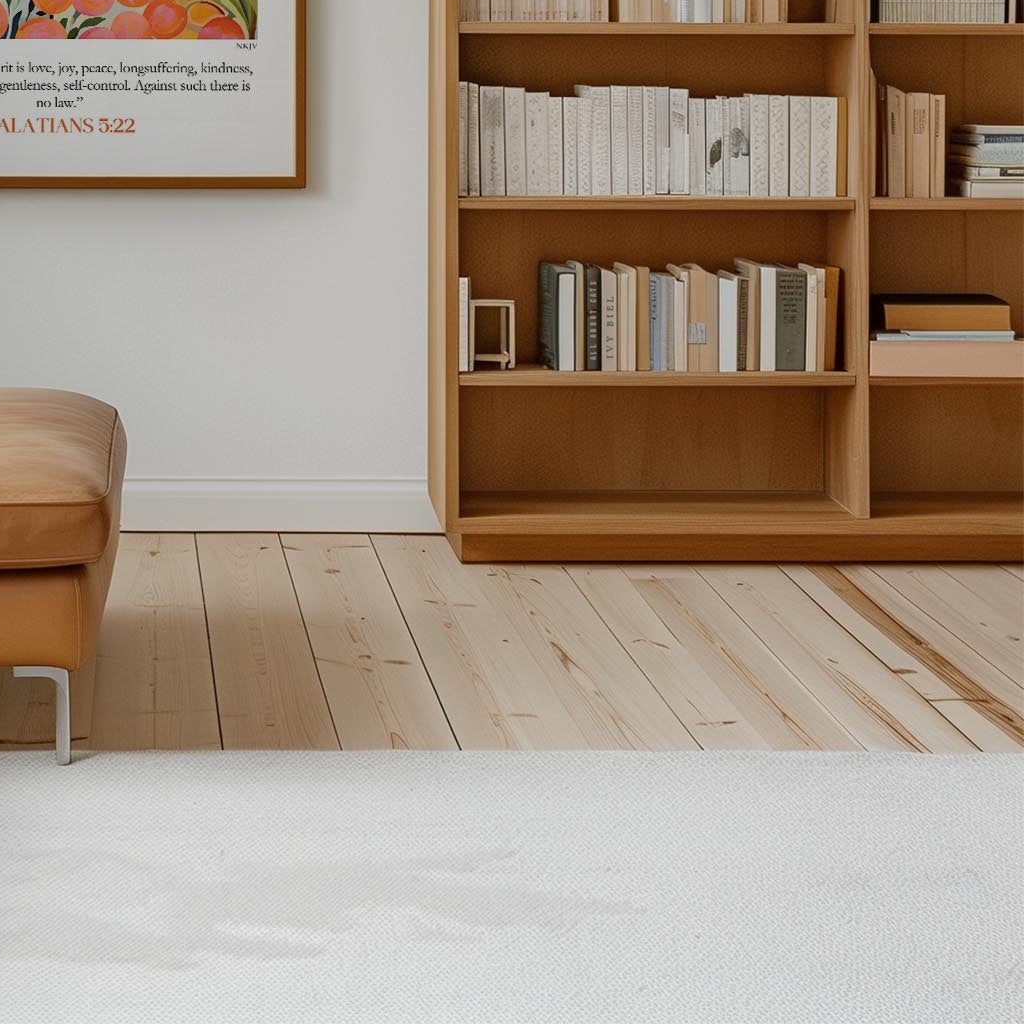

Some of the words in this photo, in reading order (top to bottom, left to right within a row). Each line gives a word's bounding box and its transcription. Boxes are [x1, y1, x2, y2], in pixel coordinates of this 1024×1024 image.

[236, 41, 257, 51] NKJV
[16, 62, 25, 73] is
[28, 61, 55, 75] love,
[58, 62, 78, 77] joy,
[81, 64, 117, 77] peace,
[119, 61, 198, 77] longsuffering,
[201, 61, 253, 75] kindness,
[0, 79, 61, 94] gentleness,
[63, 79, 131, 92] self-control.
[134, 79, 177, 94] Against
[180, 79, 207, 92] such
[210, 79, 239, 92] there
[241, 79, 251, 92] is
[36, 99, 51, 108] no
[54, 96, 84, 108] law.”
[98, 117, 136, 134] 5:22
[589, 281, 597, 303] CATS
[605, 296, 615, 327] BIEL
[589, 310, 597, 338] ABOUT
[589, 344, 597, 361] ALL
[605, 335, 615, 359] IVY
